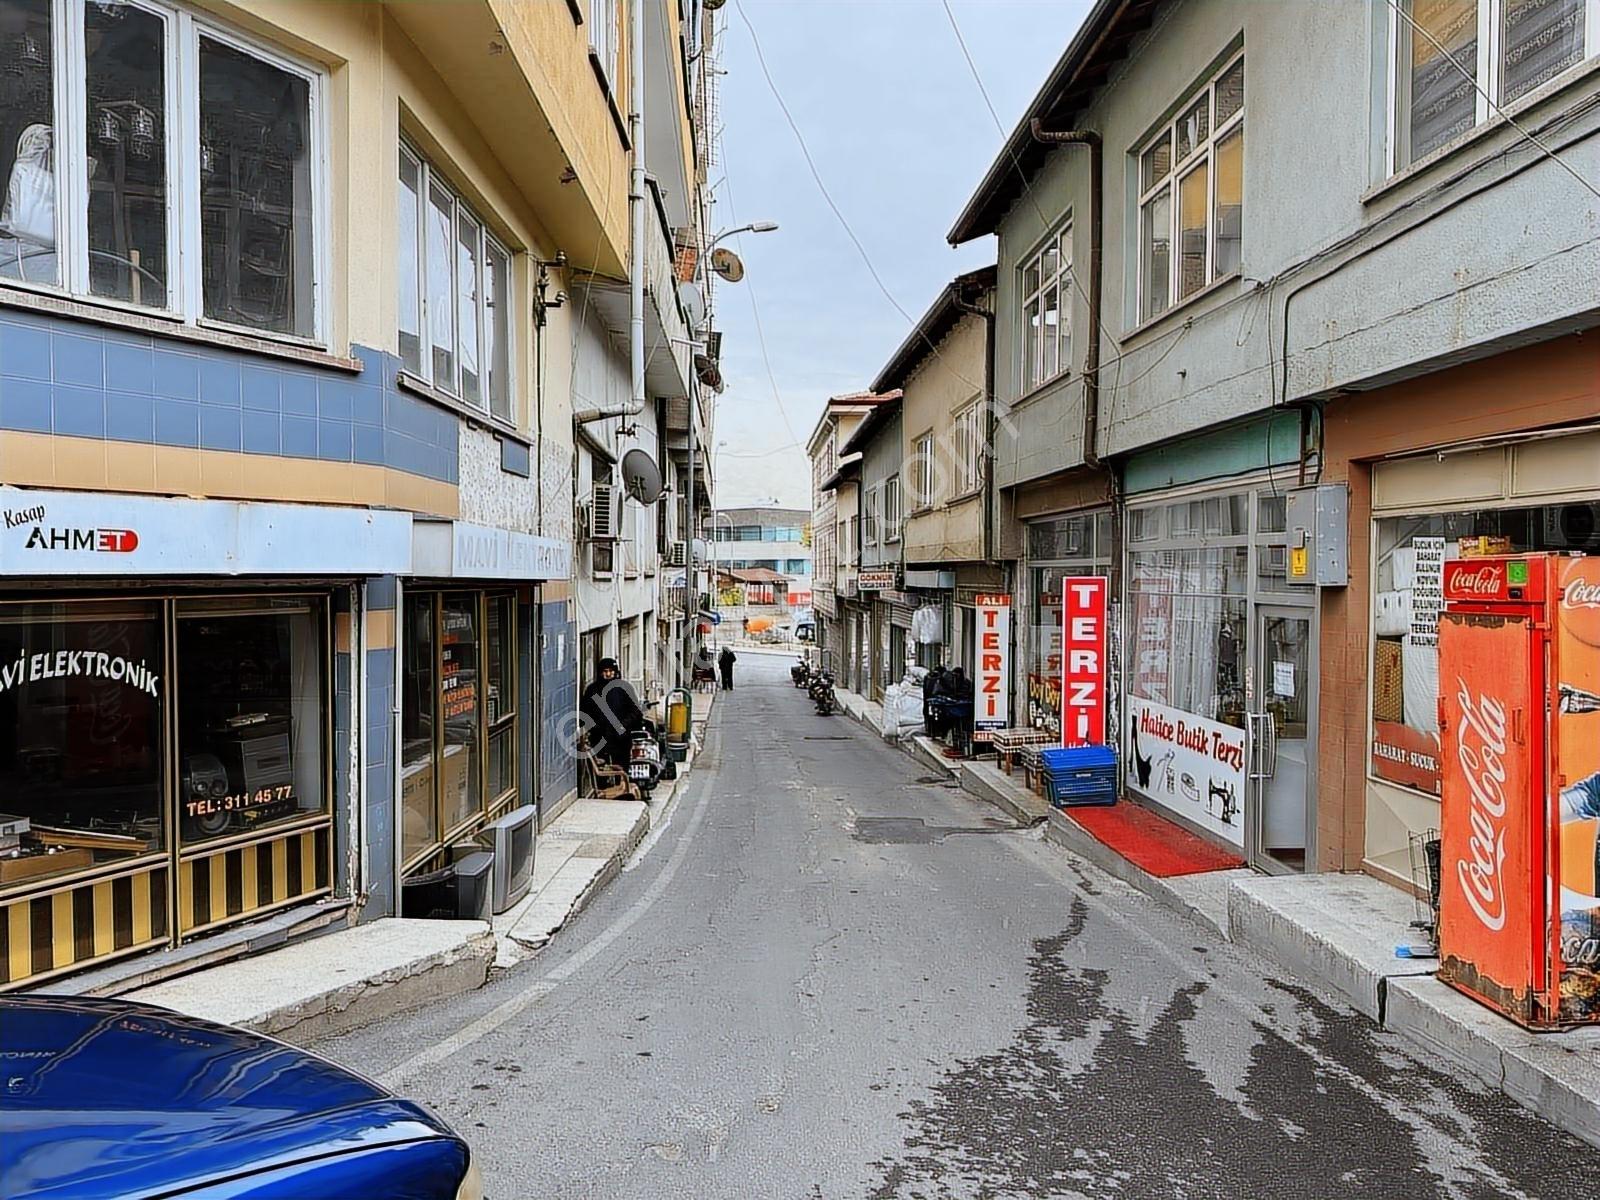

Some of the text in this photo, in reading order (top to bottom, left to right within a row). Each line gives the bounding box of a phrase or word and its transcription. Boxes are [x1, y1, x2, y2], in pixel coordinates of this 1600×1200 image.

[3, 504, 46, 529] Kasap
[25, 526, 133, 552] AHMET
[29, 650, 159, 698] ELEKTRONİK
[982, 611, 1002, 716] TERZİ
[1069, 584, 1099, 738] TERZİ
[1140, 708, 1244, 773] Hatice Butik Terzi
[186, 785, 293, 817] TEL: 311 45 77
[1456, 674, 1508, 931] Coca-Cola
